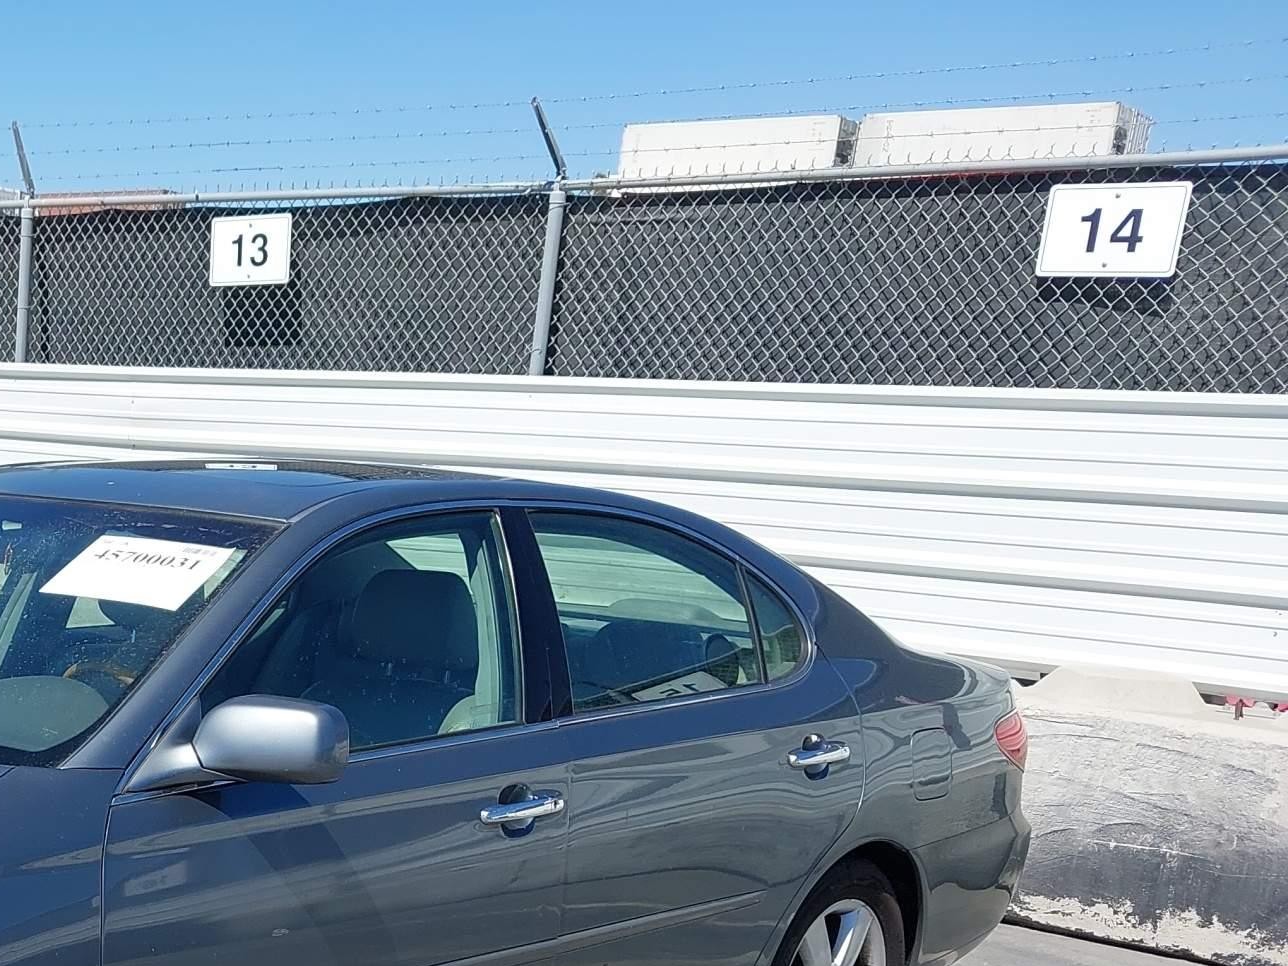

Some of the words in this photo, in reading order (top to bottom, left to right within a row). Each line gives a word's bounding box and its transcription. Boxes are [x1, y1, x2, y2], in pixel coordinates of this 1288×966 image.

[1081, 208, 1144, 252] 14
[232, 233, 268, 267] 13
[94, 549, 203, 571] 45700031
